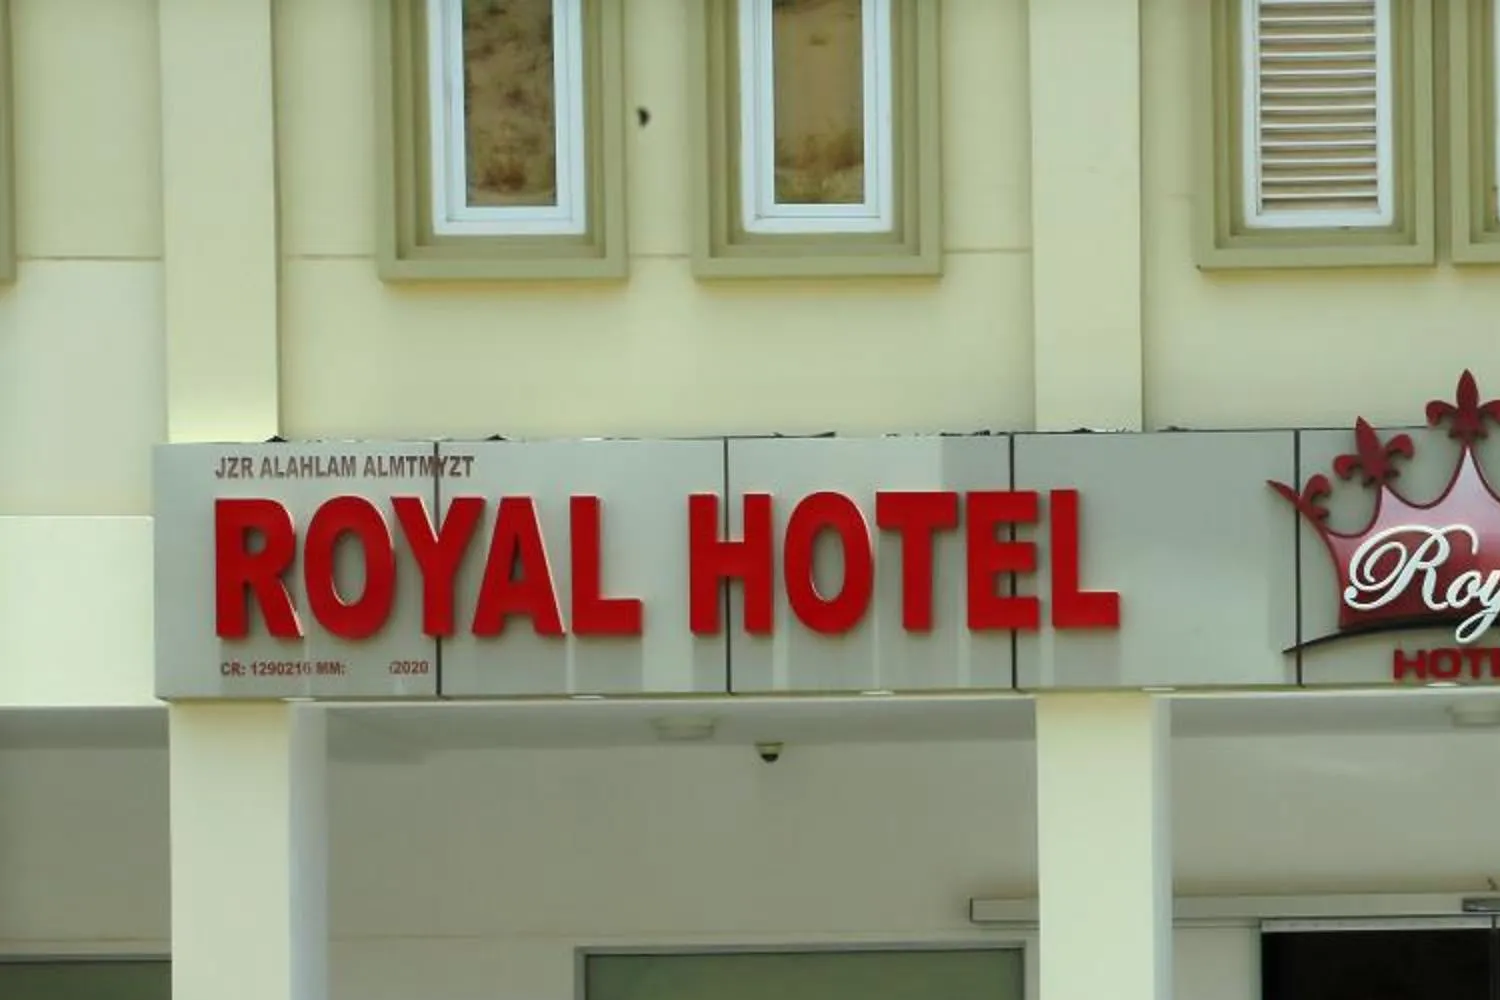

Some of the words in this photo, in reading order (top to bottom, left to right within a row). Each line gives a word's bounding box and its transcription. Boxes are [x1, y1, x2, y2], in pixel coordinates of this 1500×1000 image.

[215, 456, 254, 479] JZR
[259, 455, 357, 479] ALAHLAM
[363, 454, 475, 478] ALMTMYZT
[214, 495, 644, 640] ROYAL
[688, 488, 1121, 637] HOTEL
[220, 660, 246, 676] CR:
